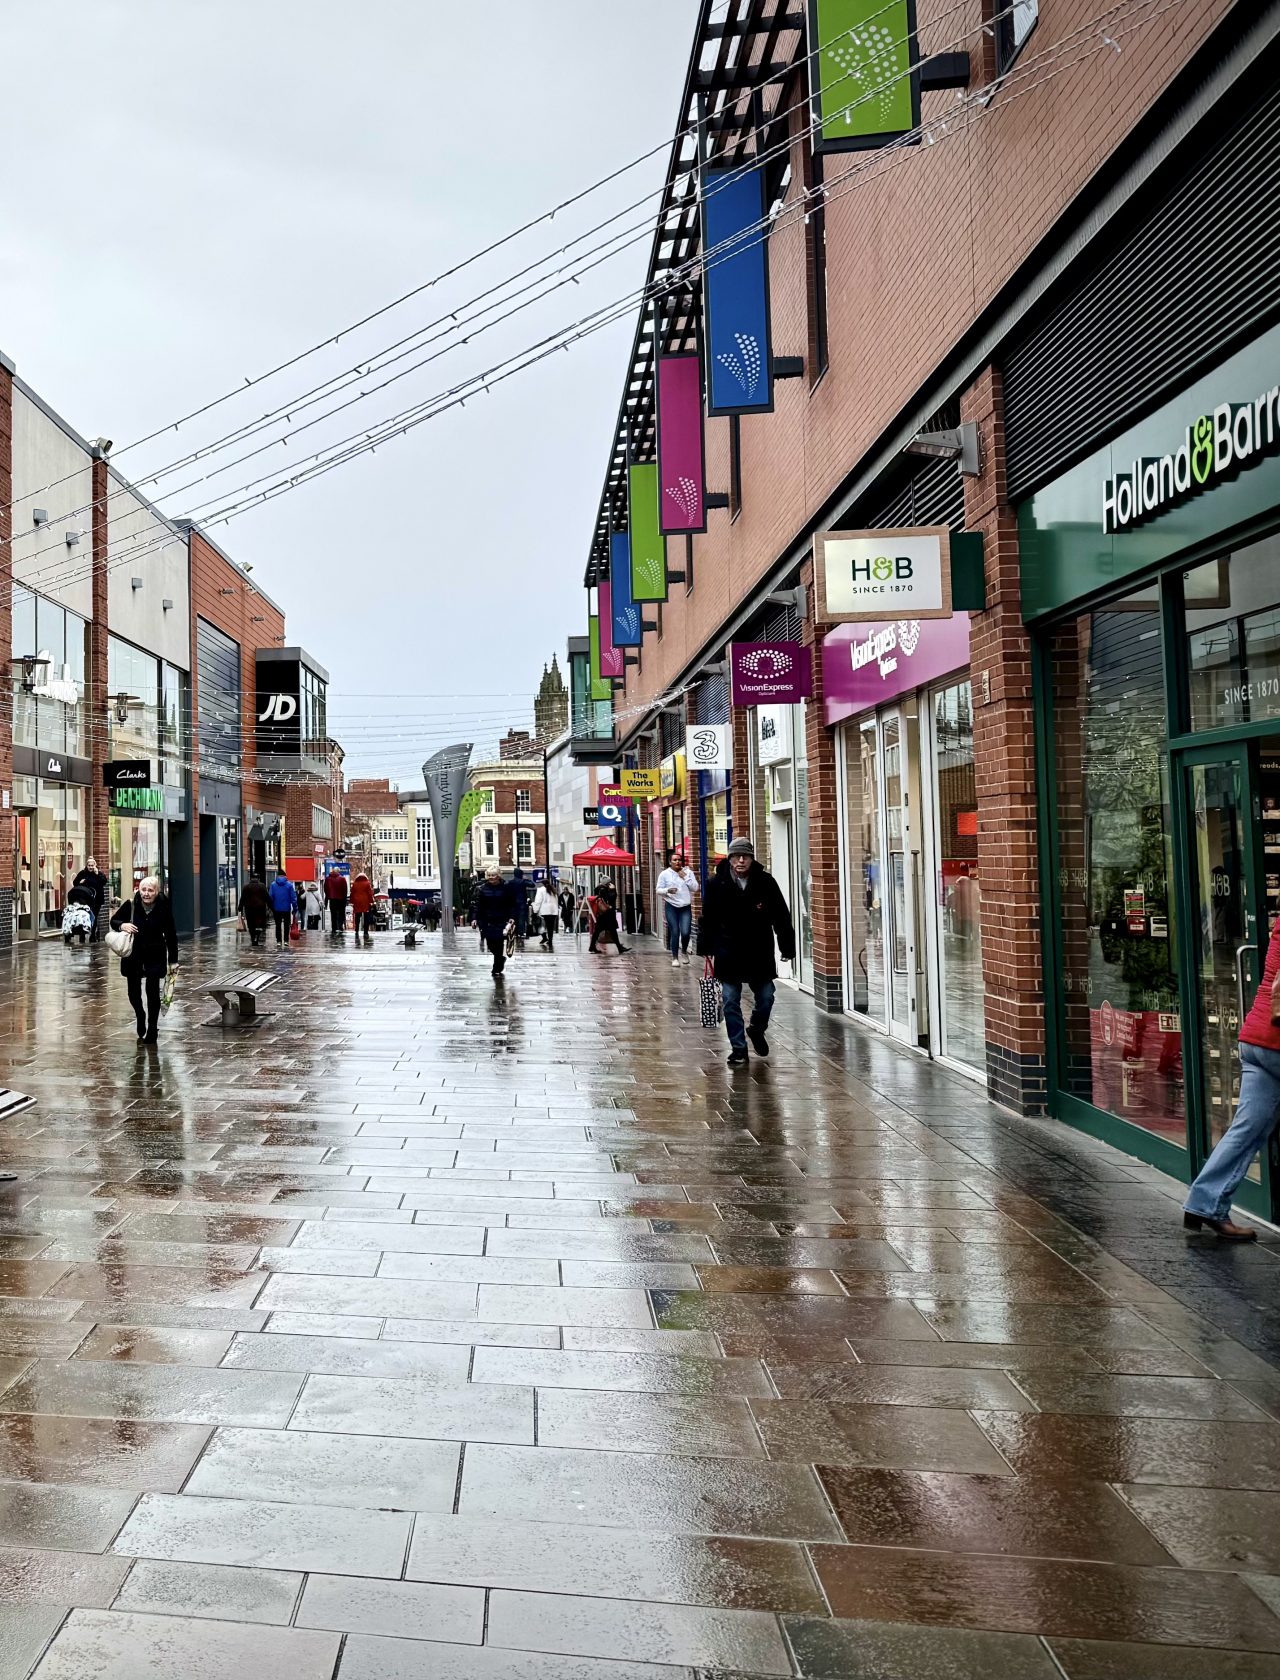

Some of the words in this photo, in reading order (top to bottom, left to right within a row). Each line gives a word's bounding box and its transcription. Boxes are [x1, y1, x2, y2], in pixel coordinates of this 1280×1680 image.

[851, 556, 914, 581] H&B
[852, 585, 885, 594] SINCE
[889, 584, 914, 593] 1870
[739, 683, 794, 693] VisionExpress
[1224, 684, 1253, 705] SINCE
[1256, 678, 1279, 698] 1870
[259, 694, 297, 722] JD
[693, 730, 719, 760] 3
[116, 769, 147, 780] Clarks
[632, 771, 648, 779] The
